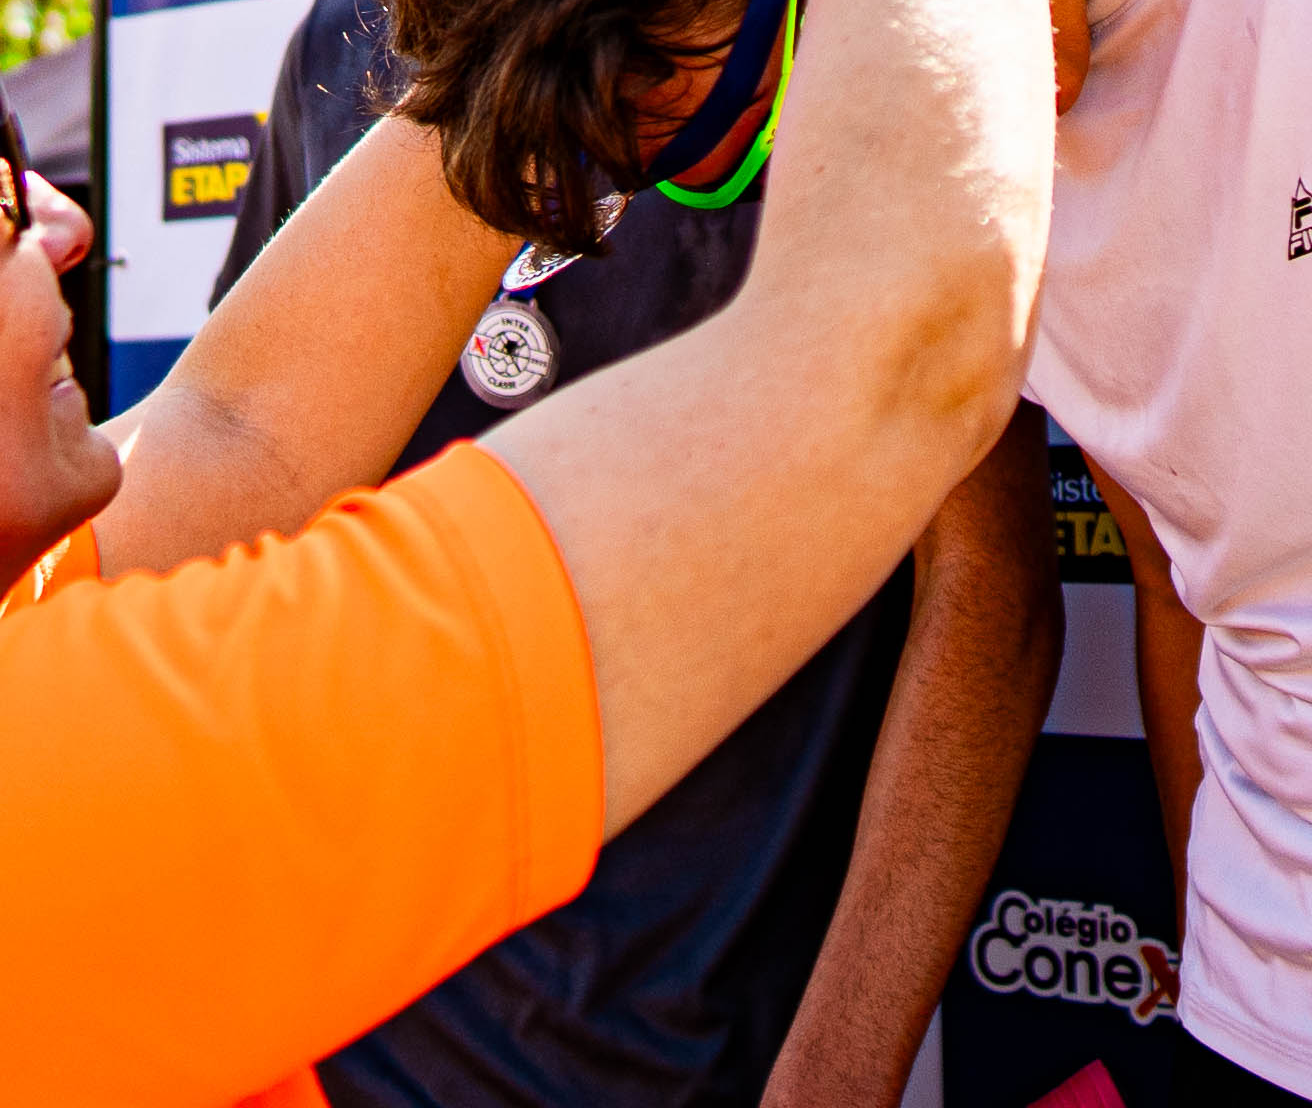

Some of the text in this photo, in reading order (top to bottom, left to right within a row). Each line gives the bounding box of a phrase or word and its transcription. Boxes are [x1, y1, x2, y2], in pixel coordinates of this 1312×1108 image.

[170, 161, 250, 205] ETAP
[999, 897, 1132, 947] Colégio
[975, 928, 1180, 1018] ConeX
